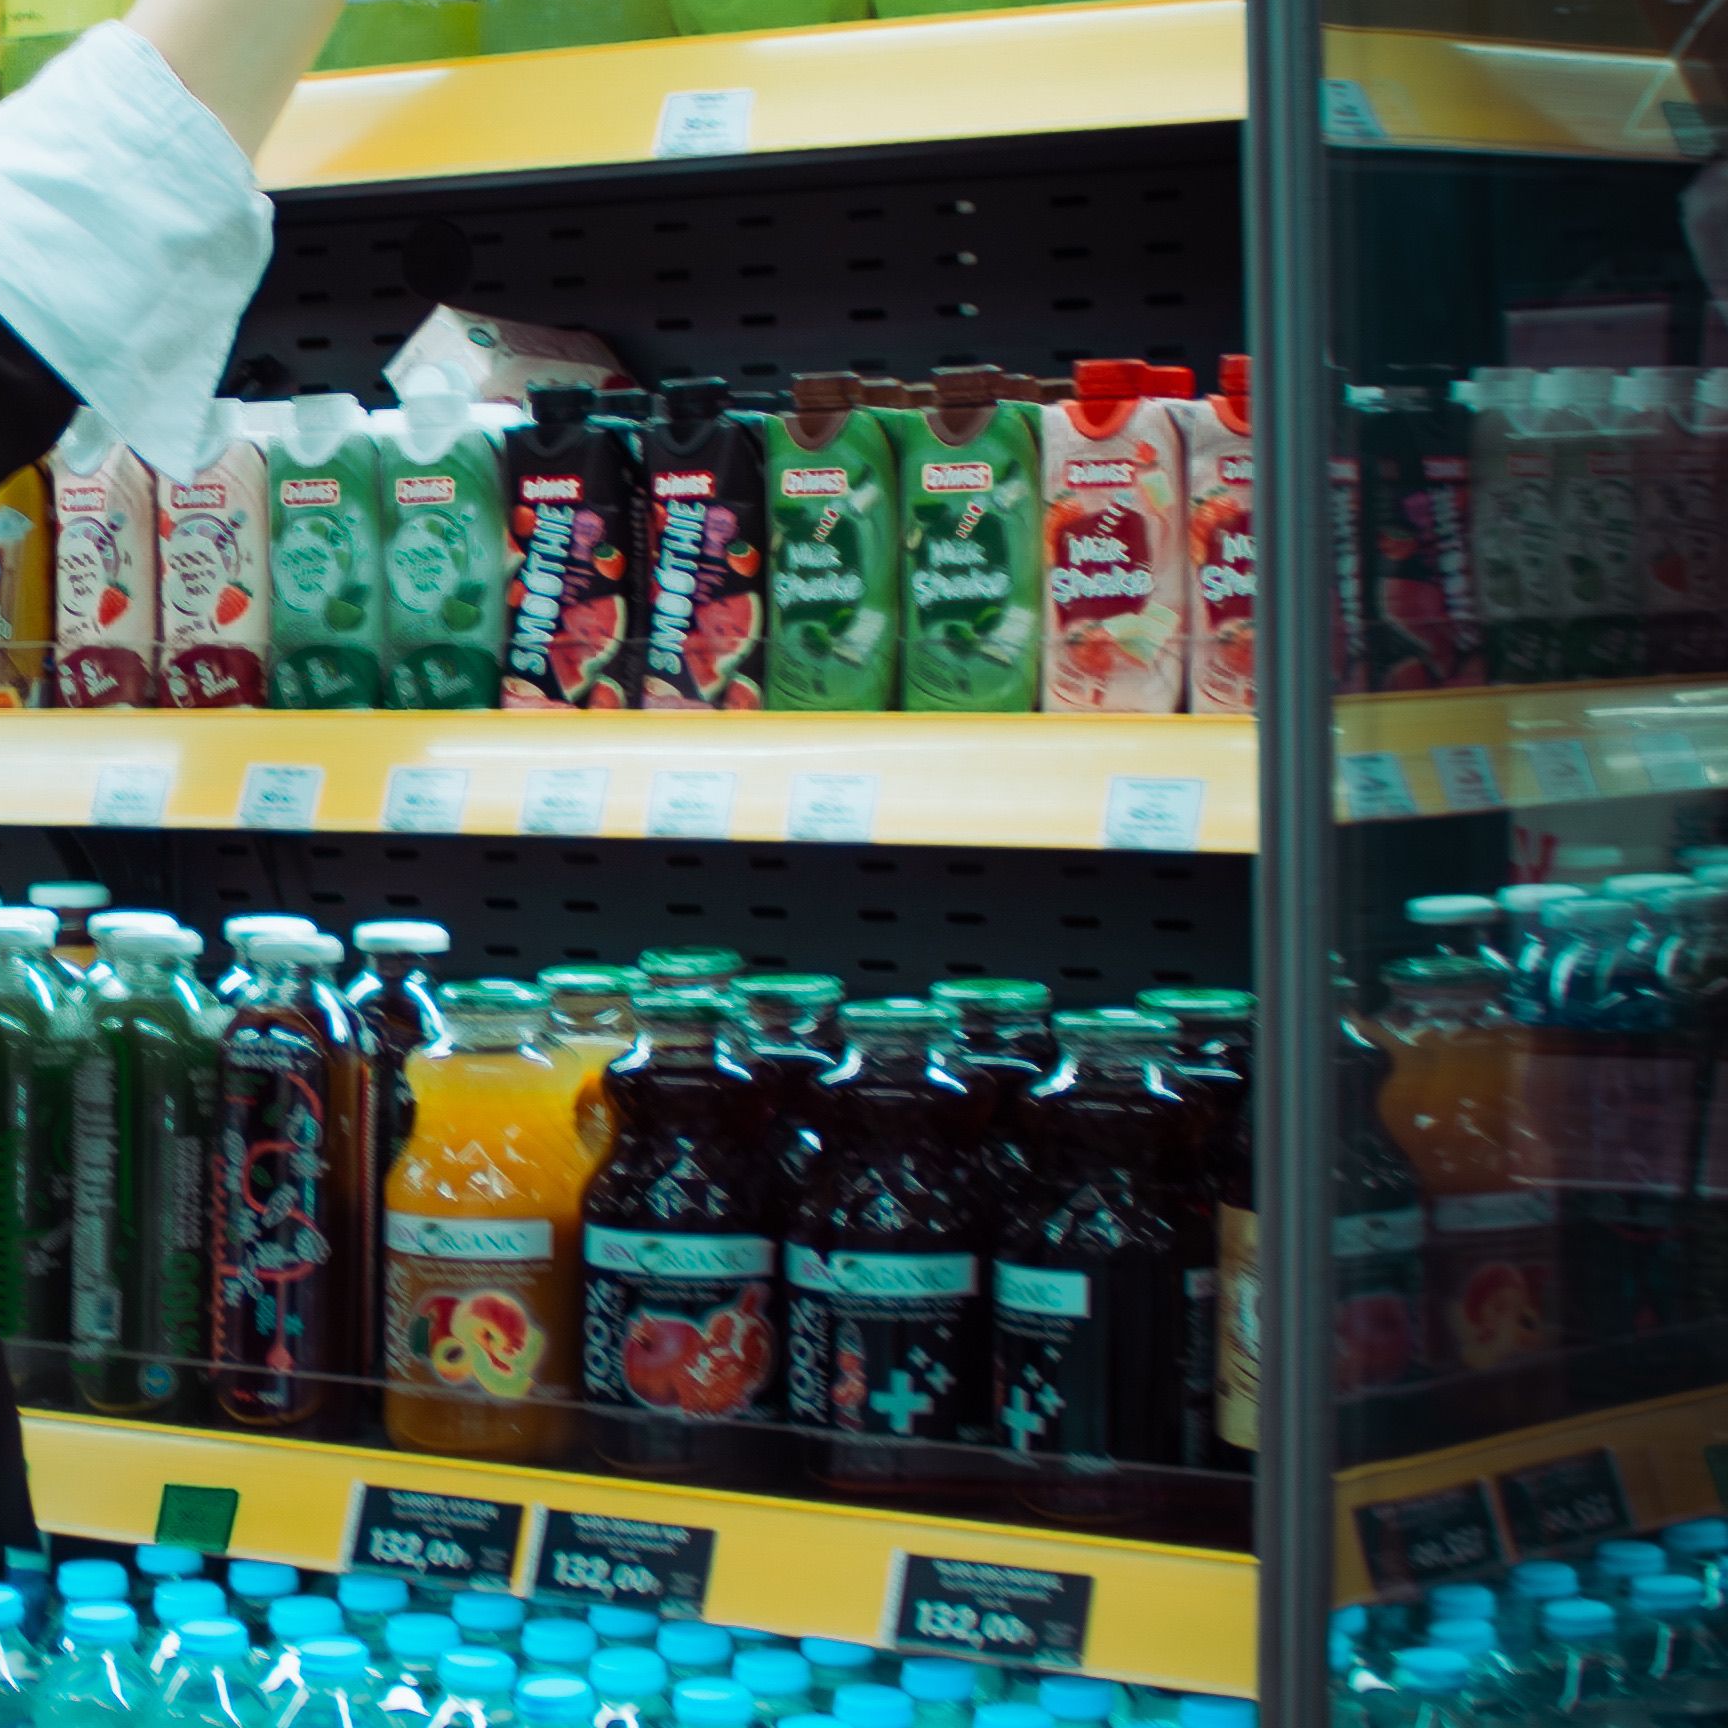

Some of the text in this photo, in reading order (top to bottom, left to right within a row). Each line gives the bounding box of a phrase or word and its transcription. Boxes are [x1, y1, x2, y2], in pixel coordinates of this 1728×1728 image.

[508, 502, 575, 676] SMOOTHIE
[649, 499, 707, 675] SMOOTHIE
[912, 567, 1011, 608] Shake
[1051, 565, 1154, 604] Shake
[1066, 533, 1131, 567] Milk
[774, 572, 865, 609] Shake
[584, 1279, 616, 1396] 100%
[787, 1297, 821, 1421] 100%
